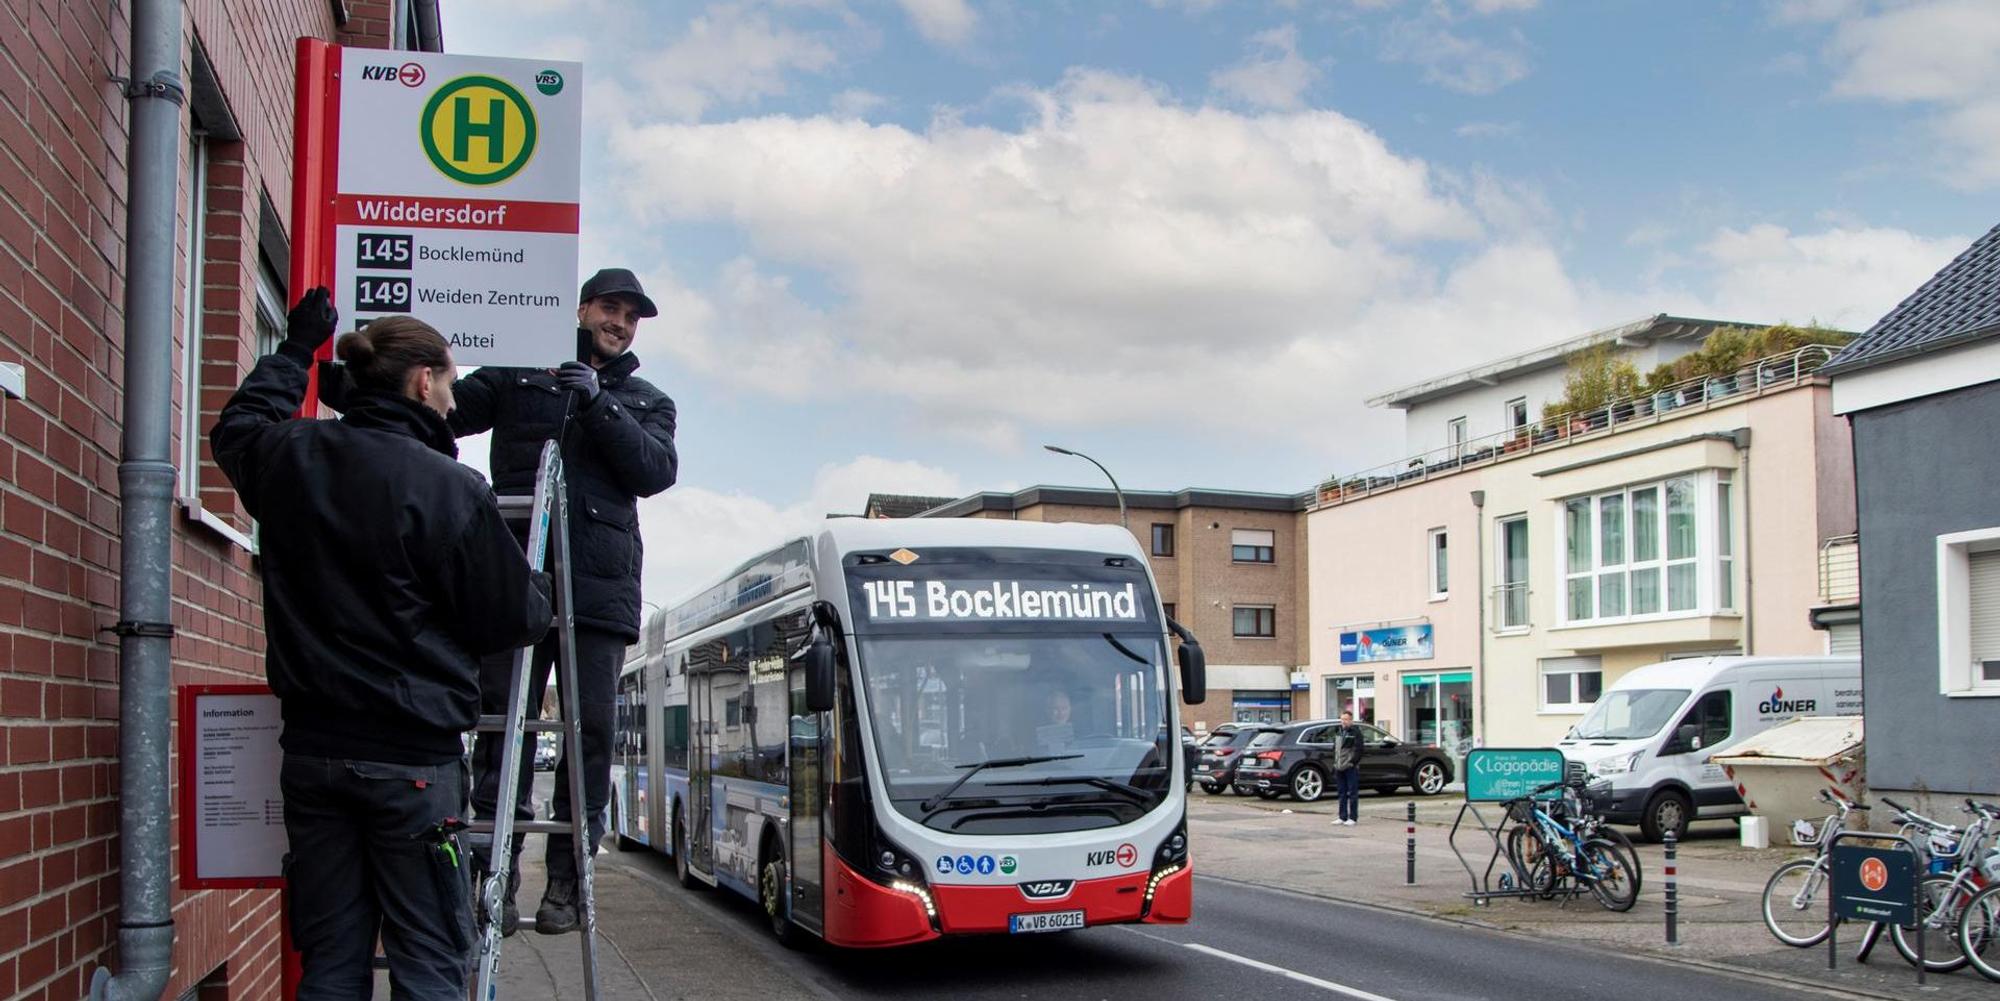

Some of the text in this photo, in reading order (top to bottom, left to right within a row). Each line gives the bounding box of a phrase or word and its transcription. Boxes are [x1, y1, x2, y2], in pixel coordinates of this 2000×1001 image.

[362, 65, 398, 81] KVB
[535, 74, 557, 85] VRS
[453, 96, 506, 164] H
[356, 200, 507, 225] Widdersdorf
[360, 238, 525, 264] 145 Bocklemünd
[359, 281, 560, 307] 149 Weiden Zentrum
[450, 332, 495, 348] Abtei
[863, 580, 1137, 619] 145 Bocklemünd
[203, 708, 255, 718] Information
[1486, 757, 1559, 776] Logopädie
[1086, 850, 1116, 867] KVB
[1027, 882, 1065, 895] VDL
[1034, 916, 1047, 928] VB
[1049, 912, 1082, 927] 6021E
